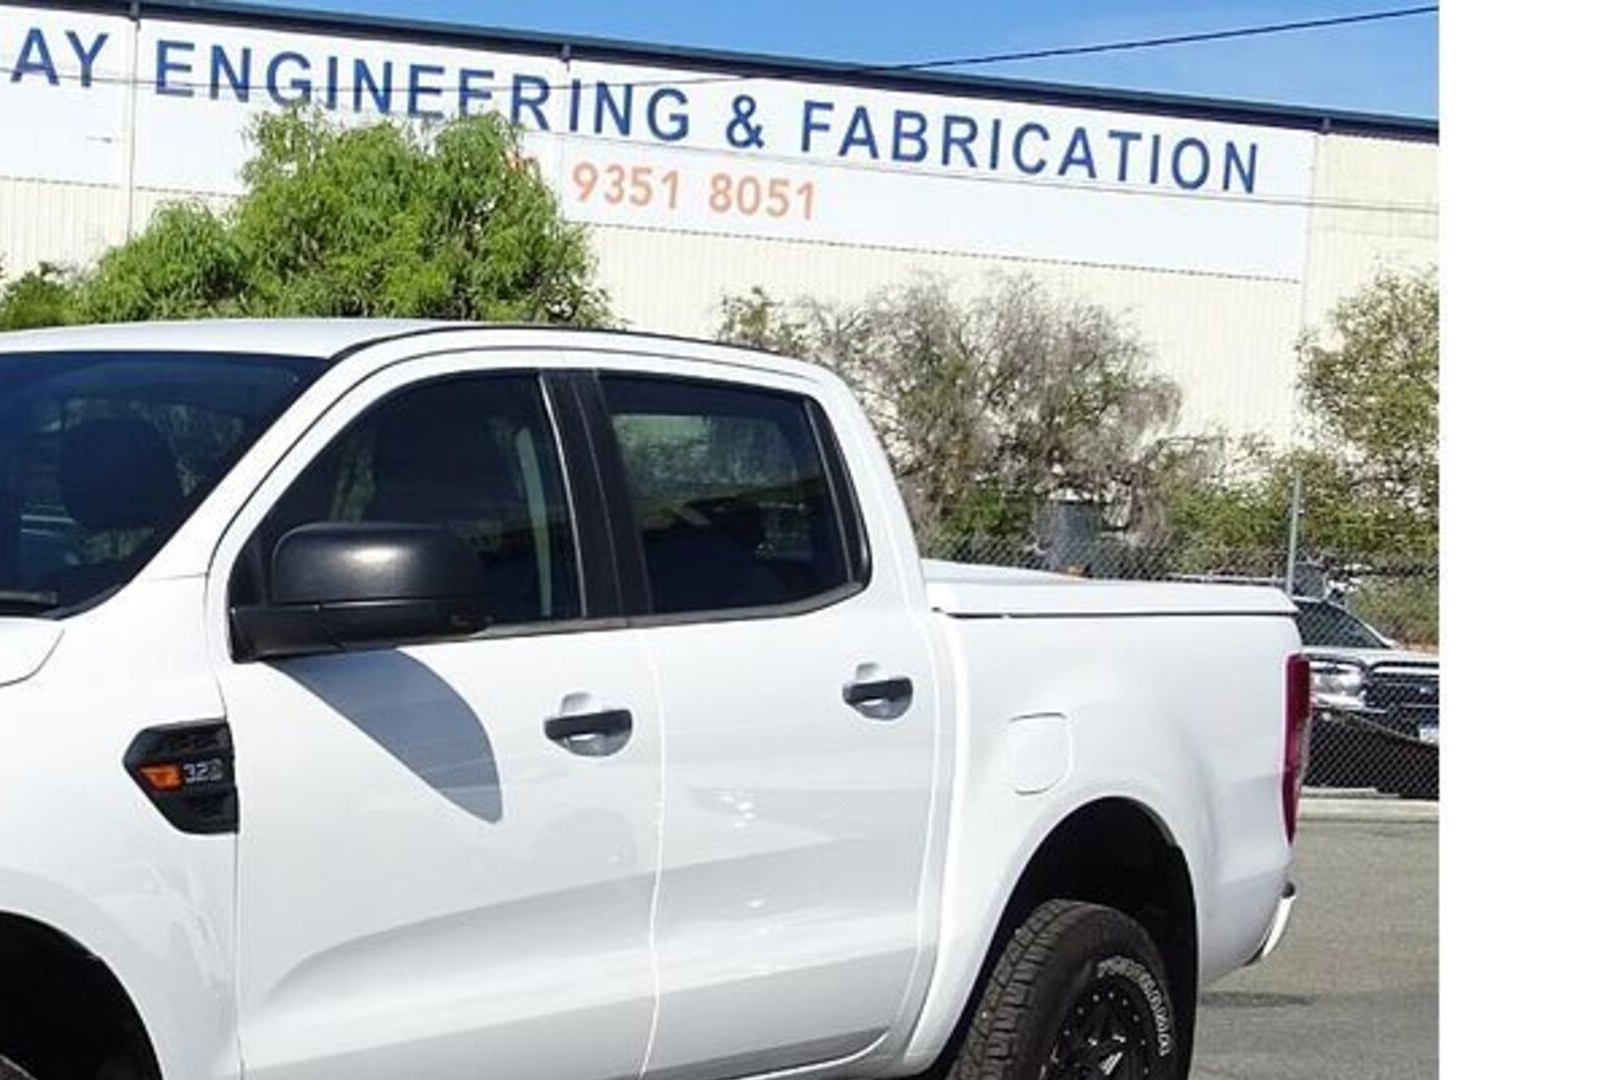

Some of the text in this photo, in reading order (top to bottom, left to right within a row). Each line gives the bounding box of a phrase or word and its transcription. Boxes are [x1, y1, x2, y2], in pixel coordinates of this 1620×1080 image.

[156, 40, 690, 142] ENGINEERING
[726, 95, 764, 149] &
[802, 100, 1257, 194] FABRICATION
[572, 162, 815, 220] 9351 8051
